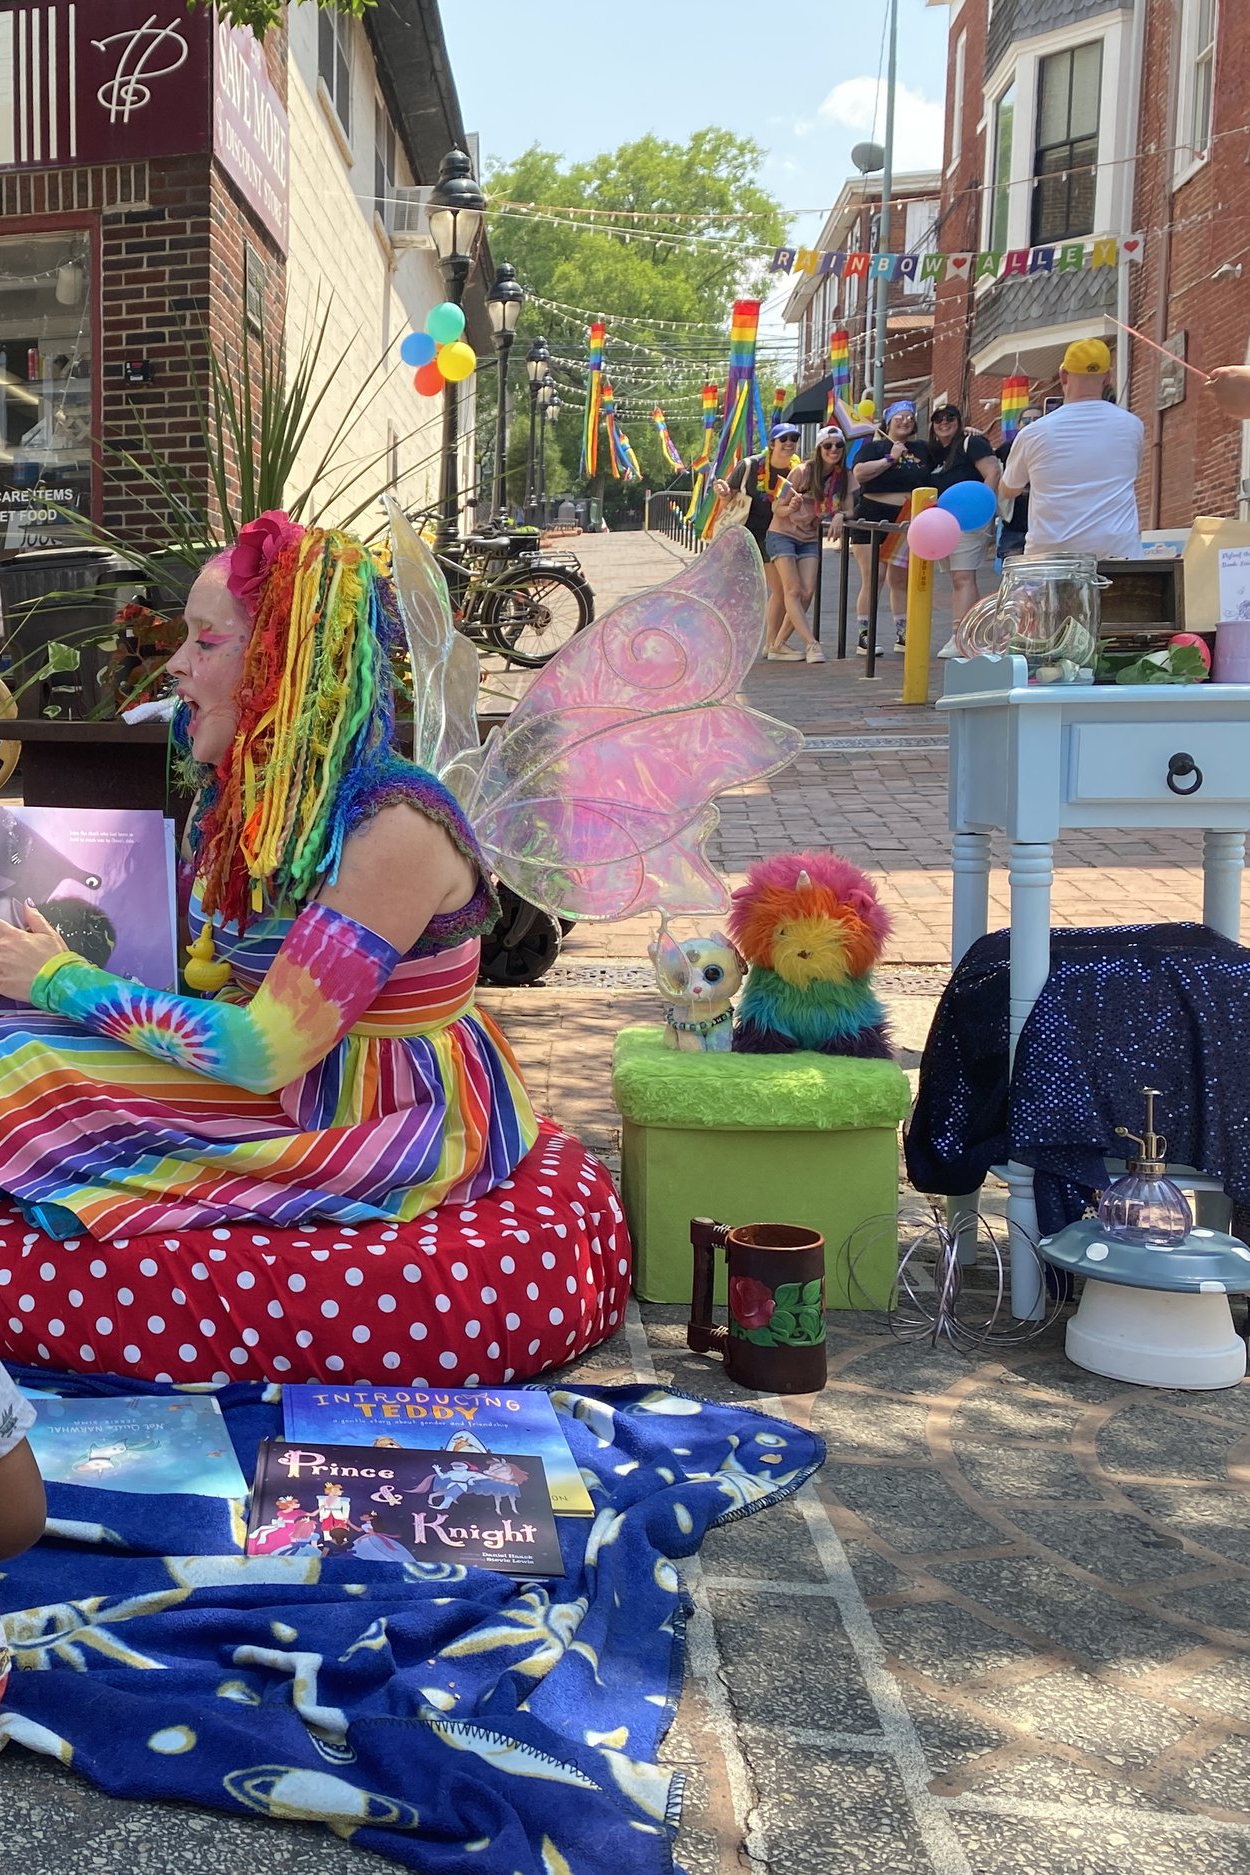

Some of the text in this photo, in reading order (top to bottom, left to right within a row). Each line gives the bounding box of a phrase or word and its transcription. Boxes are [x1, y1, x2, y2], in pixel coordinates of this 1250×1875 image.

[219, 21, 287, 188] SAVE MORE
[225, 119, 283, 228] DISCOUNT STORE
[777, 243, 1111, 272] RAINBOW ALLEY
[32, 488, 74, 502] ITEMS
[18, 508, 58, 522] FOOD
[312, 1392, 521, 1412] INTRODUCING
[354, 1403, 478, 1420] TEDDY
[277, 1450, 395, 1479] Prince
[370, 1485, 404, 1507] &
[412, 1512, 538, 1549] Knight
